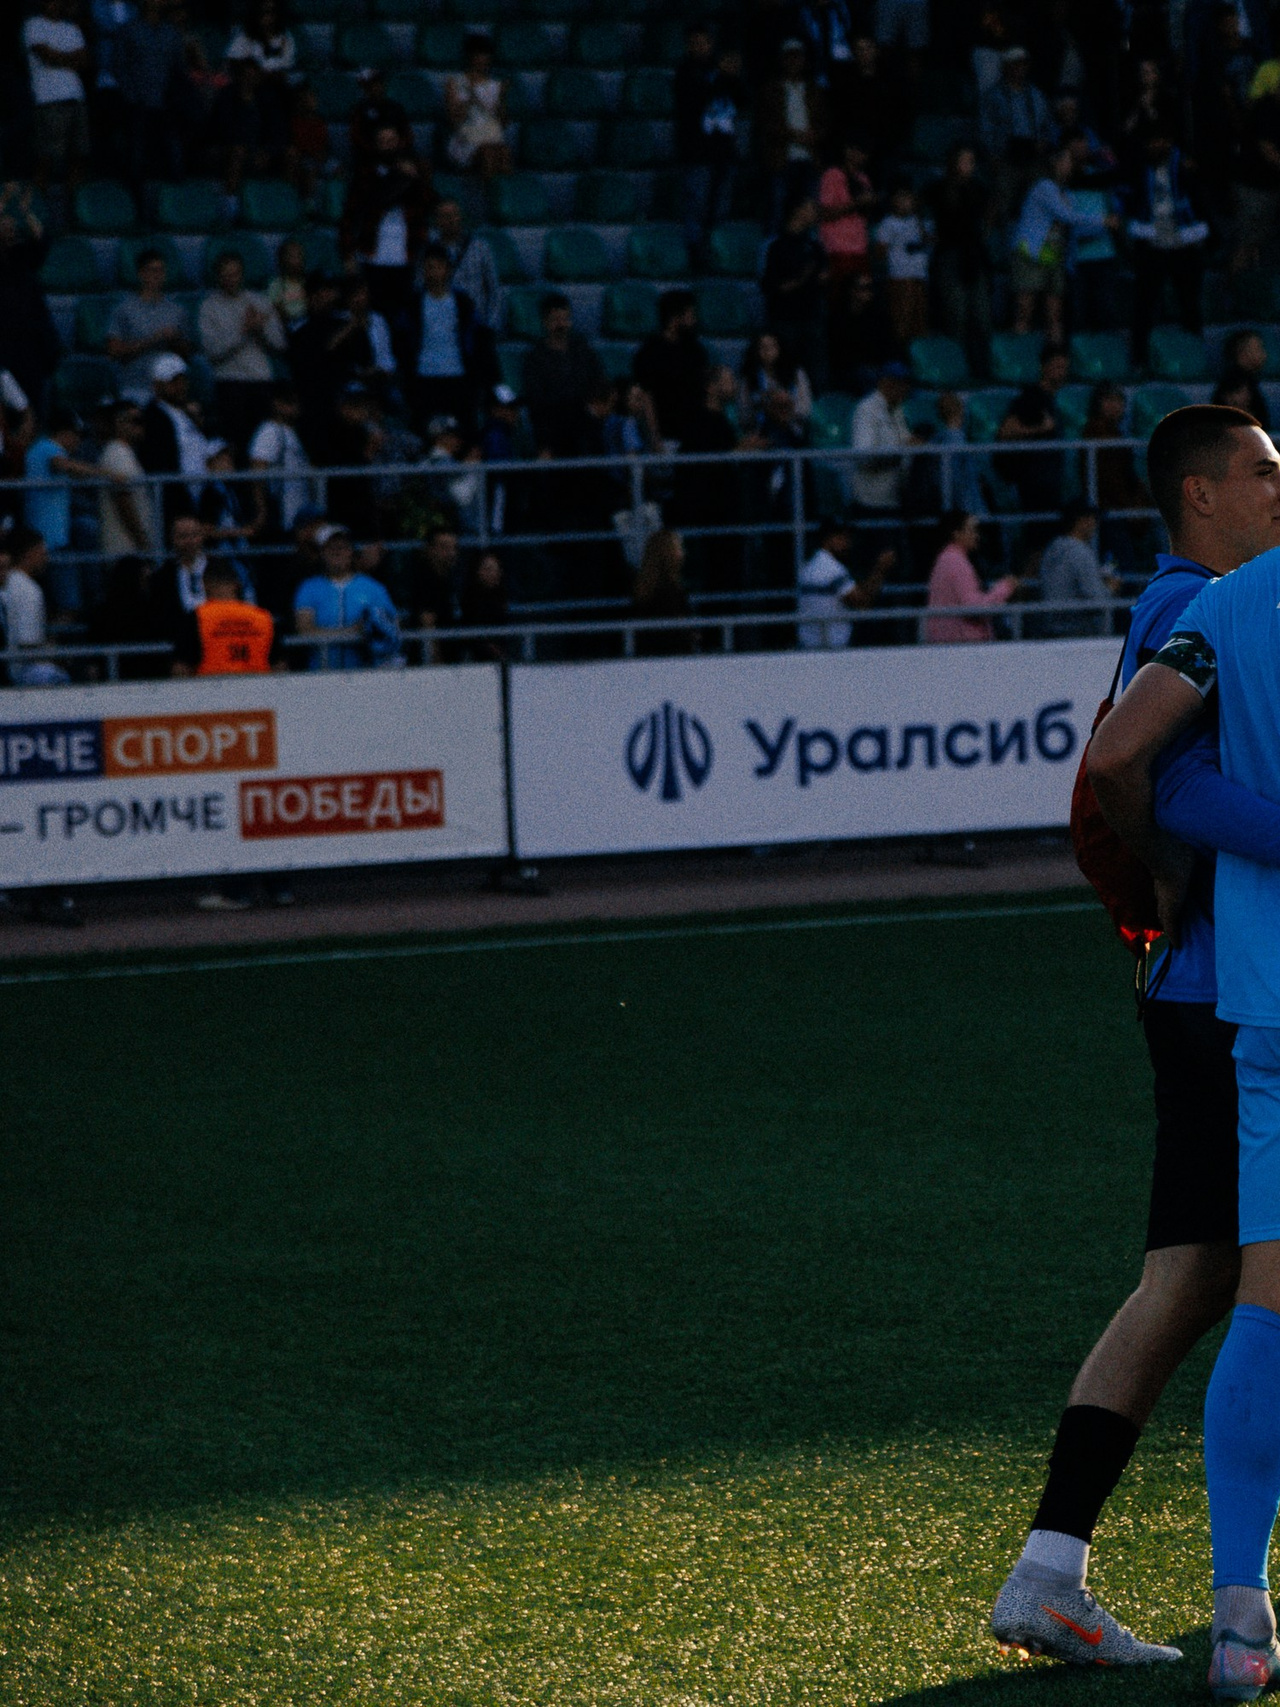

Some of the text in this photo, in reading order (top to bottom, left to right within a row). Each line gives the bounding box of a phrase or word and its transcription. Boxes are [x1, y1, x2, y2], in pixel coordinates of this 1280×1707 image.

[112, 721, 269, 769] СПОРТ
[745, 701, 1076, 788] Уралсиб
[38, 793, 226, 841] ГРОМЧЕ
[244, 777, 440, 828] ПОБЕДЫ
